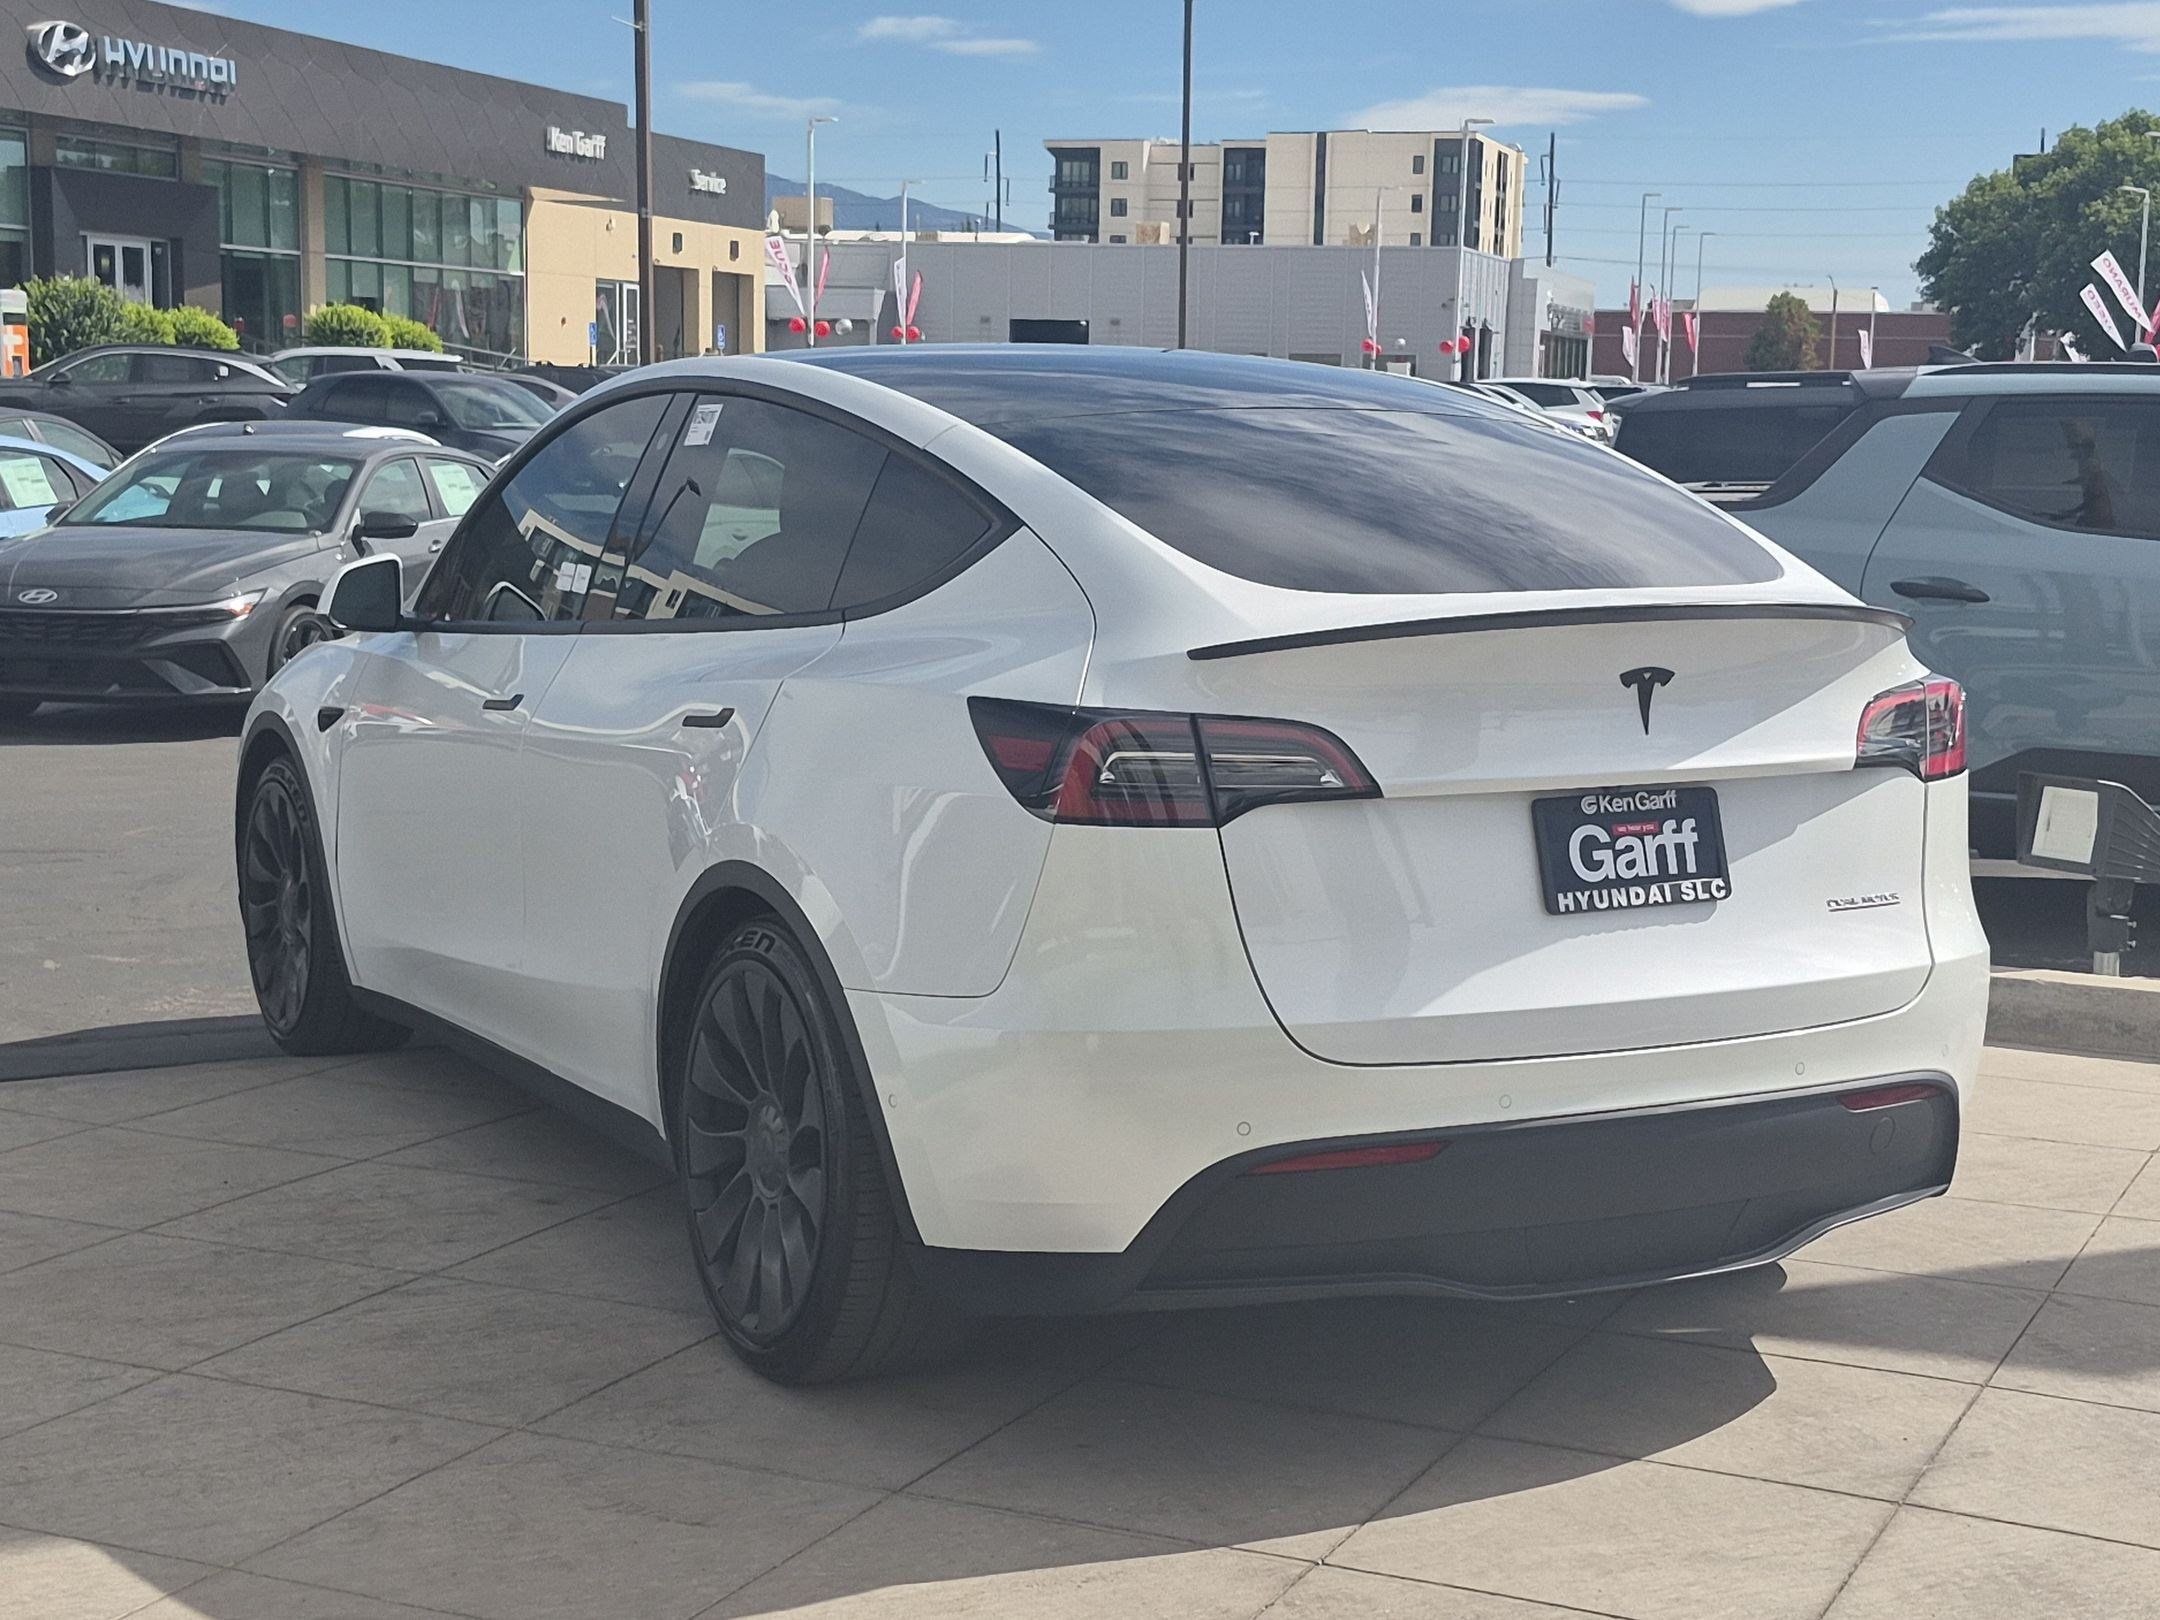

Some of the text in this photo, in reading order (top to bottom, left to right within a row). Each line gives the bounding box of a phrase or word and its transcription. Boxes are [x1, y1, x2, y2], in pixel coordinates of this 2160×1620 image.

[104, 36, 237, 85] HYUNDAI
[547, 127, 573, 154] Ken
[687, 169, 727, 195] Service
[1599, 790, 1677, 814] Ken Garff
[1568, 818, 1699, 883] Garff
[1557, 879, 1727, 912] HYUNDAI SLC
